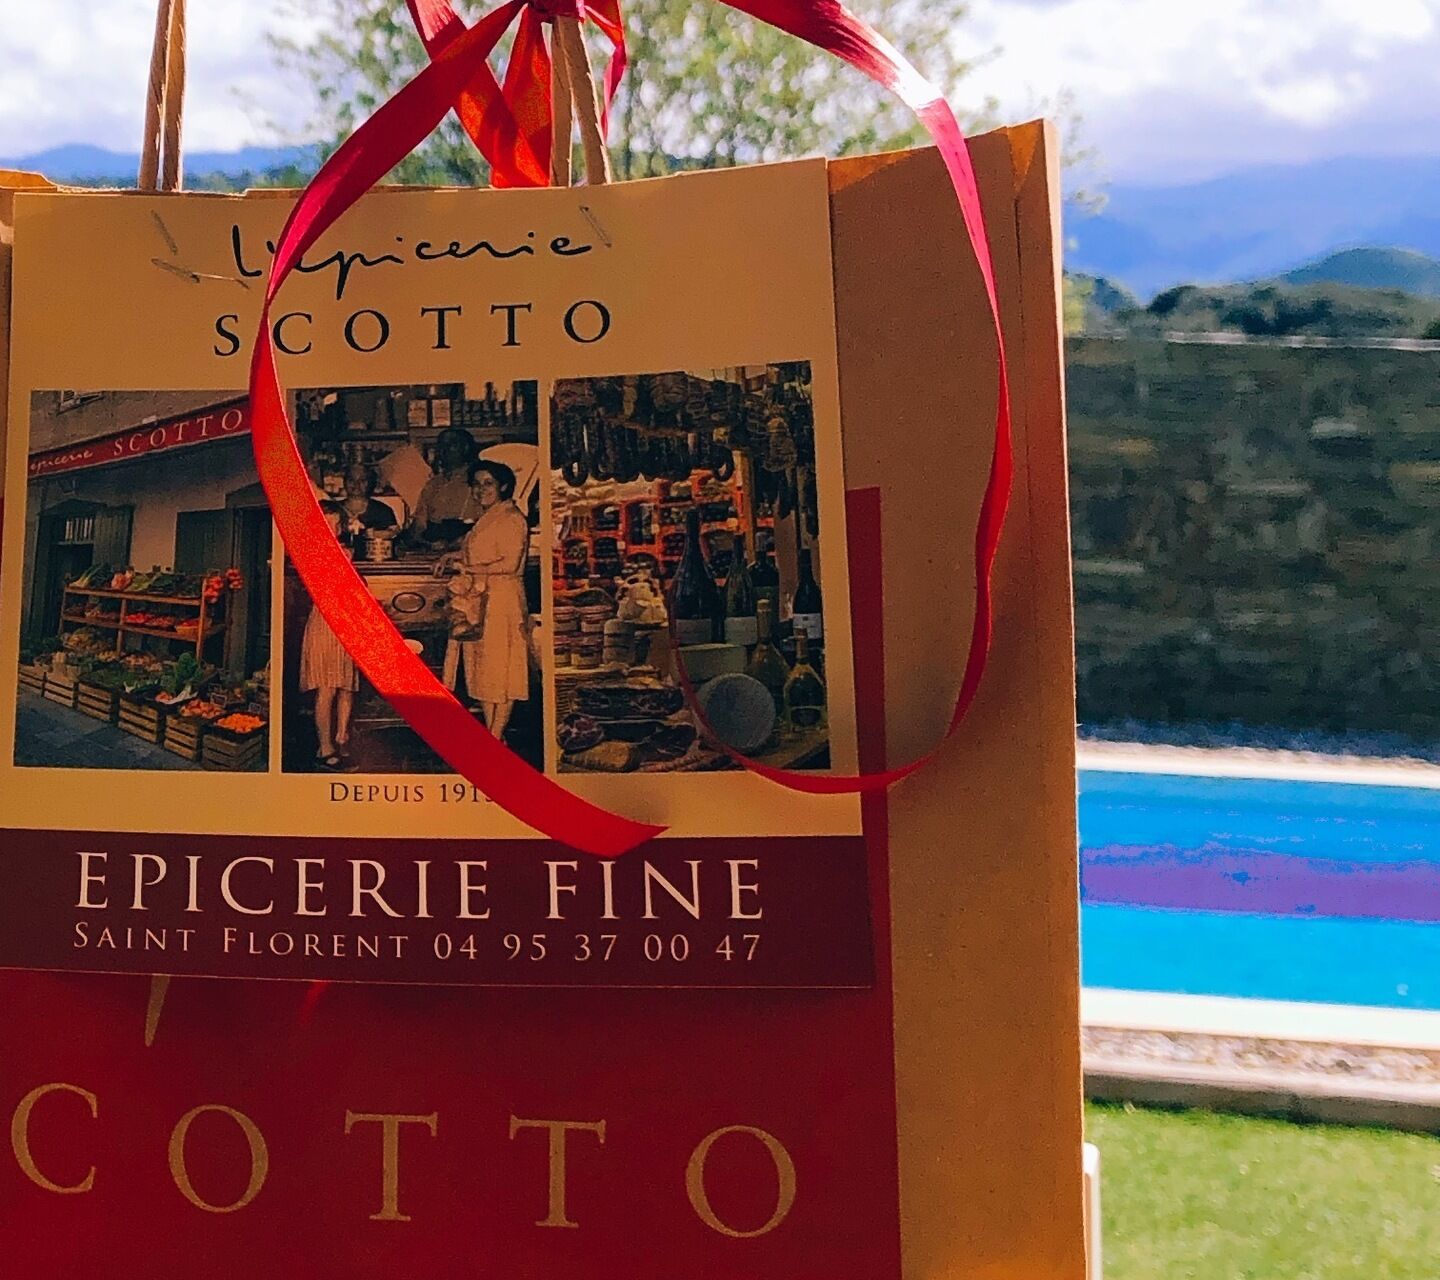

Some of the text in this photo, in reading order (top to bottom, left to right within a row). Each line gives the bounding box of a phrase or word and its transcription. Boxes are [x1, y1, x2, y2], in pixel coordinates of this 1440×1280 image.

[214, 299, 611, 357] SCOTTO
[113, 407, 244, 456] SCOTTO
[330, 782, 495, 803] DEPUIS 191
[75, 852, 764, 920] EPICERIE FINE
[74, 922, 761, 961] SAINT FLORENT 04 95 37 00 47
